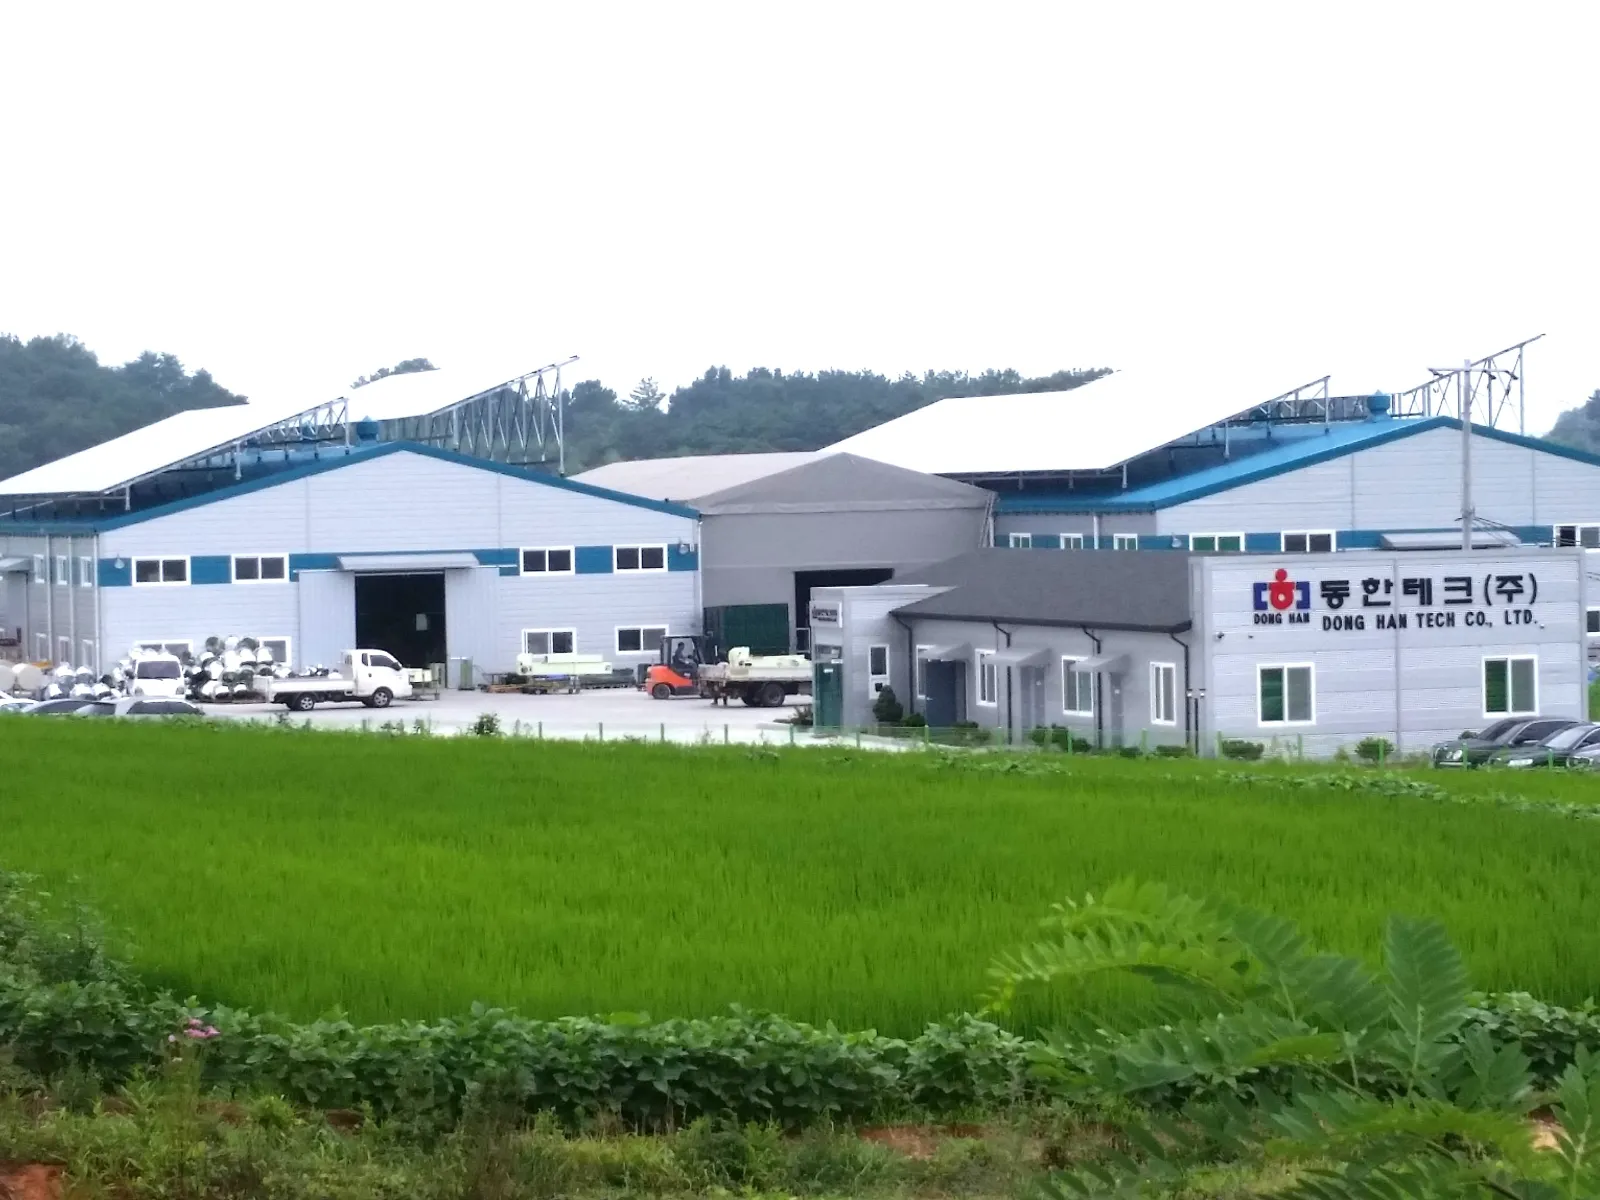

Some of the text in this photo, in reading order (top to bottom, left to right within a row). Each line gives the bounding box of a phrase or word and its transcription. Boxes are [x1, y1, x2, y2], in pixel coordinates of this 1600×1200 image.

[1254, 612, 1310, 625] DONG HAN
[1322, 615, 1364, 631] DONG
[1376, 613, 1408, 630] HAN
[1416, 611, 1455, 628] TECH
[1504, 609, 1538, 625] LTD.
